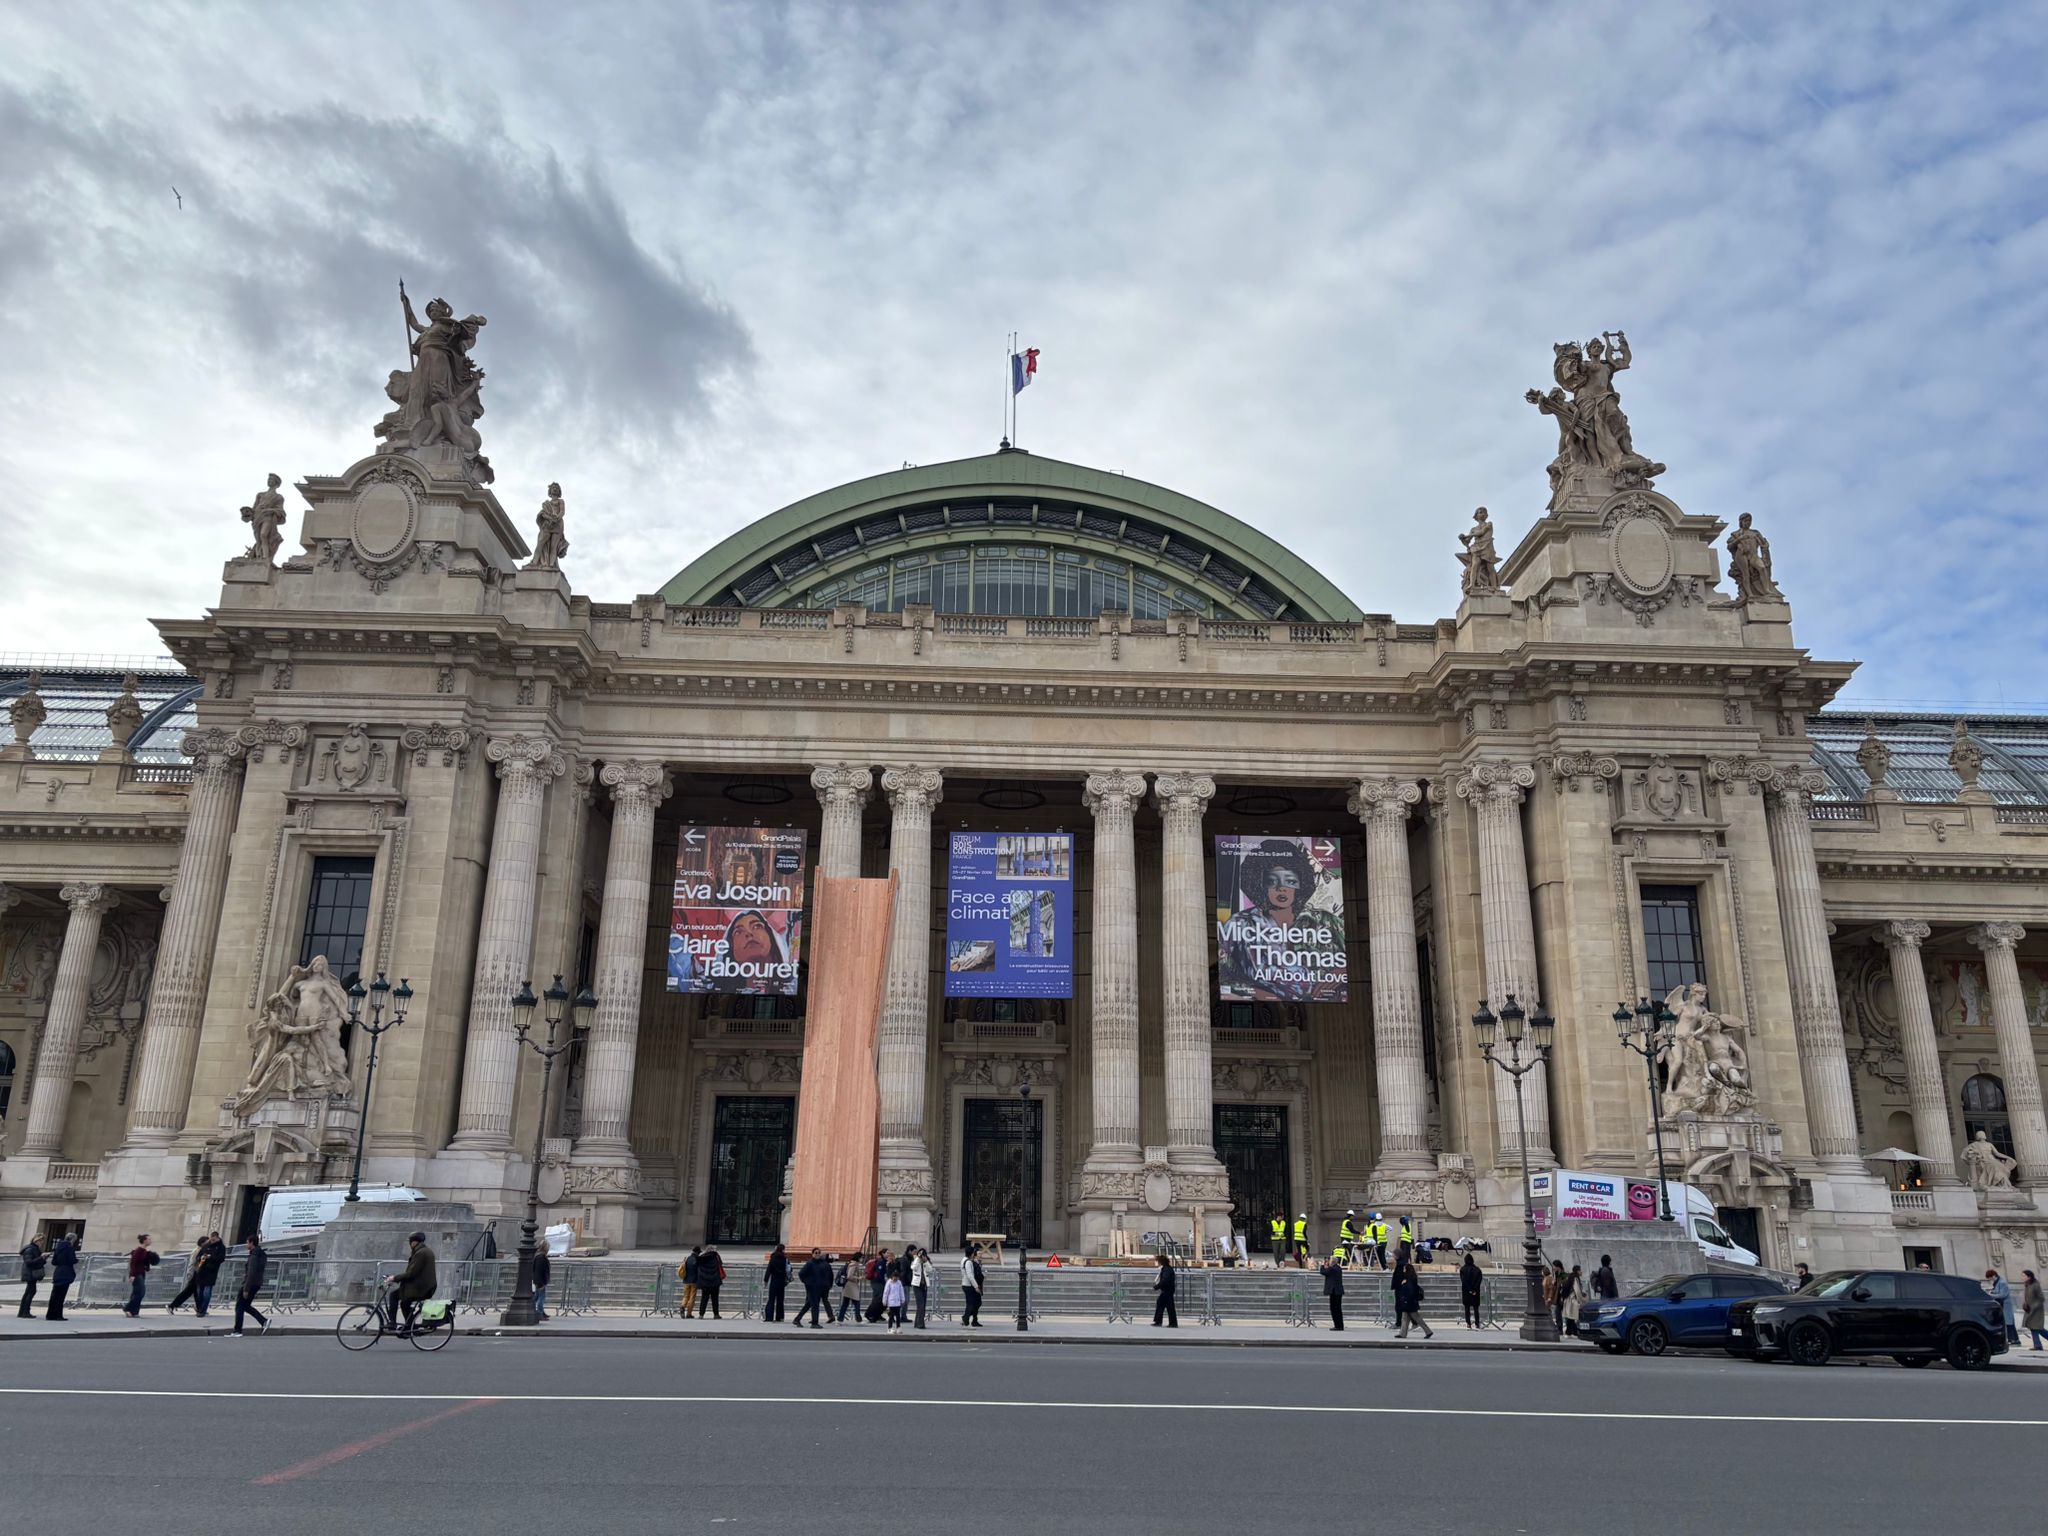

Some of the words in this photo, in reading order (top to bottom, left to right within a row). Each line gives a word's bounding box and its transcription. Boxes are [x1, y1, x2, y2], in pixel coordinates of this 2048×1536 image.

[761, 834, 802, 842] GrandPalais
[953, 835, 981, 843] FORUM
[1220, 841, 1262, 850] GrandPalais
[953, 848, 1012, 856] CONSTRUCTION
[680, 869, 713, 877] Grottesco
[674, 879, 711, 900] Eva
[716, 881, 791, 904] Jospin
[951, 889, 995, 904] Face
[1001, 891, 1023, 904] au
[951, 905, 1010, 920] climat
[1217, 921, 1332, 944] Mickalene
[668, 933, 730, 955] Claire
[1250, 945, 1347, 968] Thomas
[699, 957, 799, 978] Tabouret
[1254, 968, 1274, 982] All
[1274, 969, 1316, 982] About
[1317, 969, 1348, 983] Love
[1571, 1182, 1589, 1190] RENT
[1596, 1185, 1611, 1193] CAR
